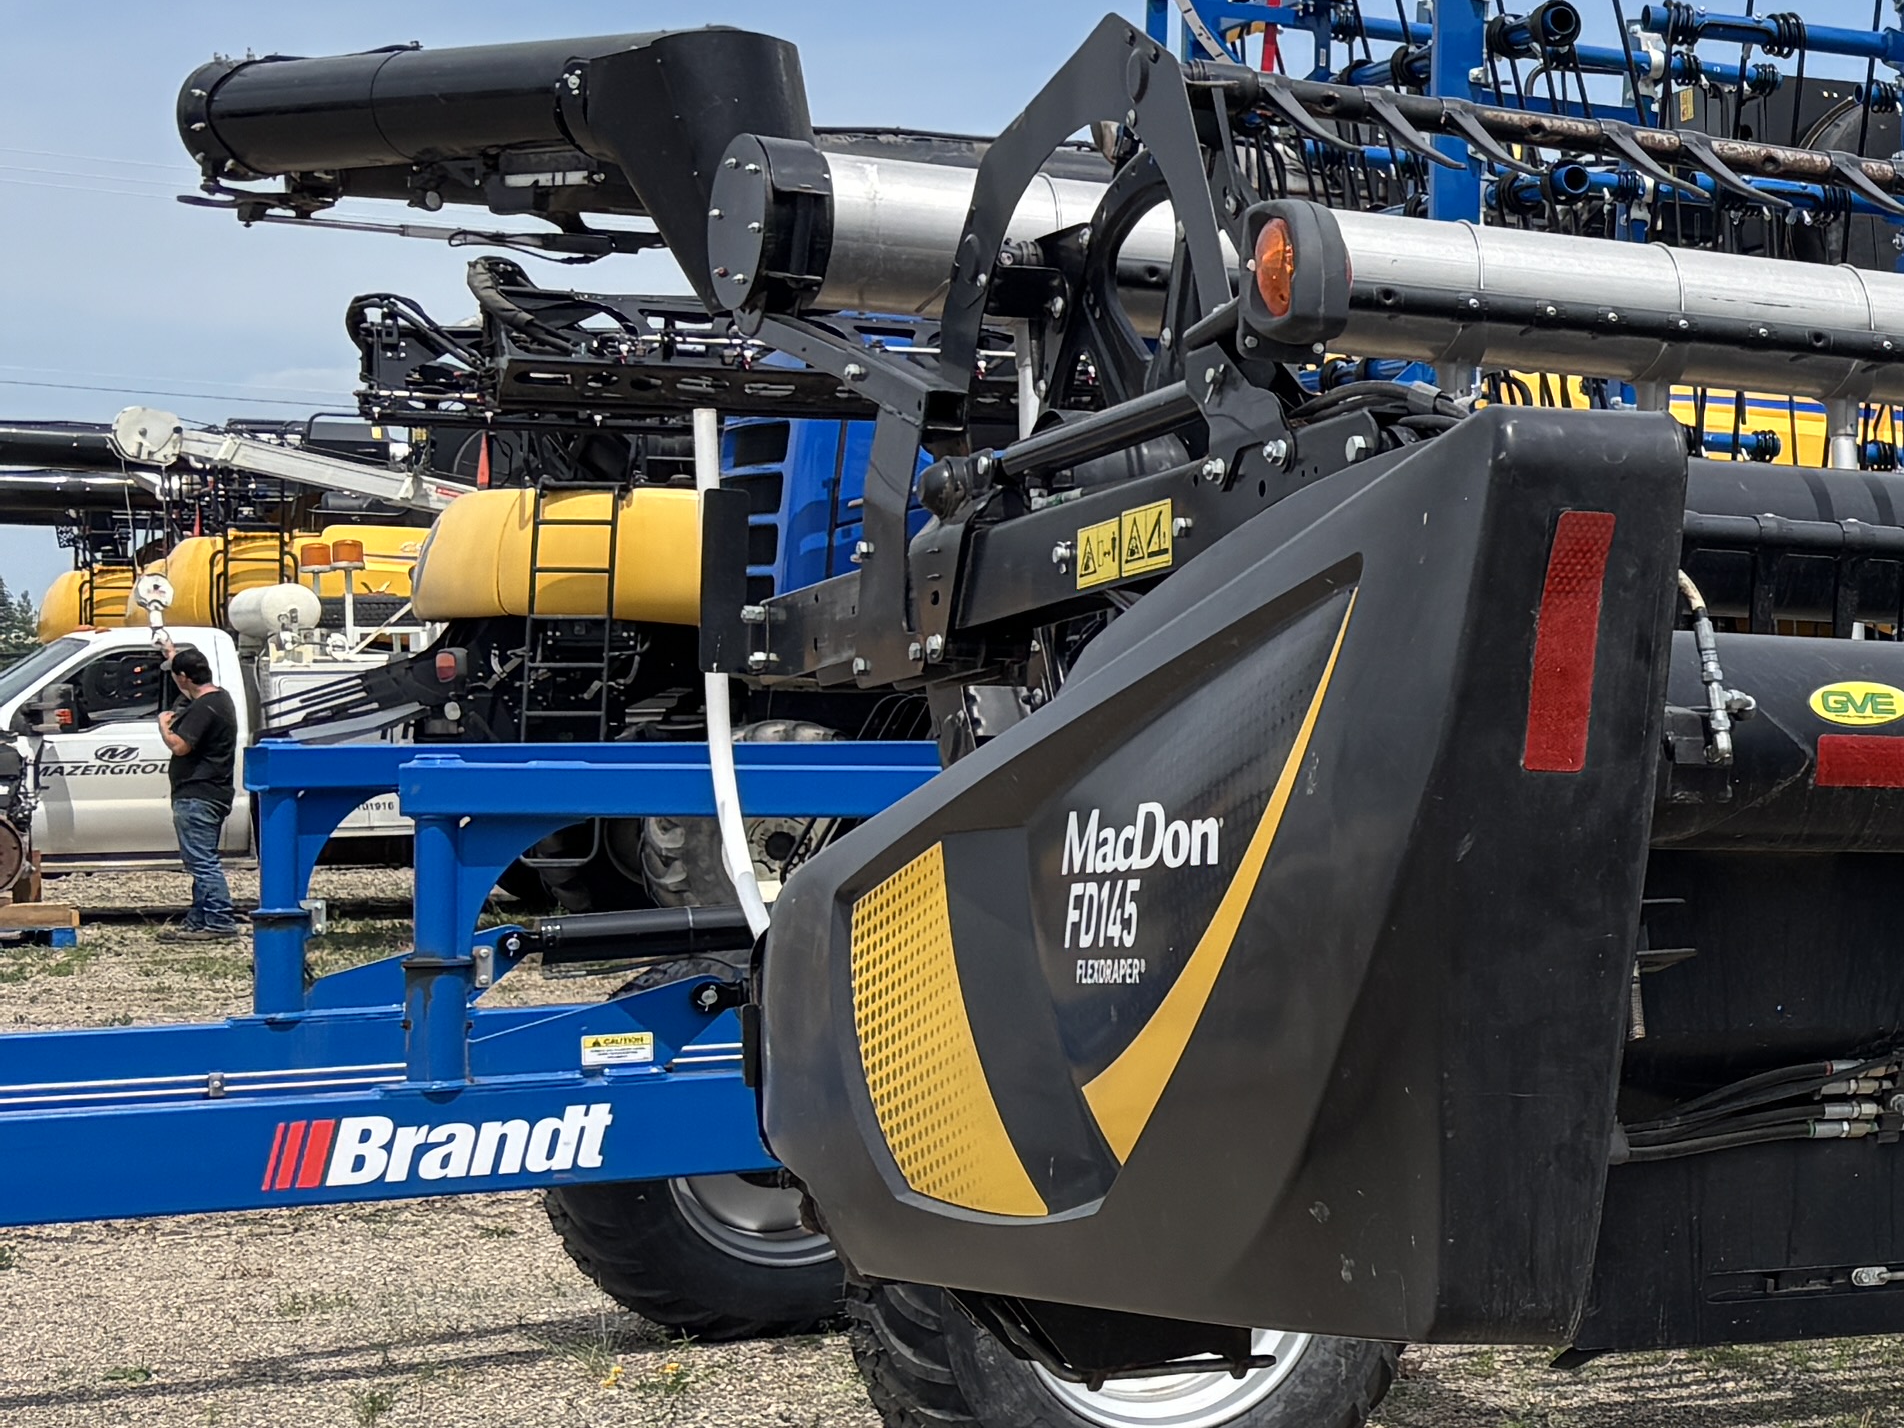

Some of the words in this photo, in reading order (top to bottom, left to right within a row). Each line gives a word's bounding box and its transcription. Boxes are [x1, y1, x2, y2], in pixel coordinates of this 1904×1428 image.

[1821, 690, 1897, 715] GVE
[1061, 801, 1220, 876] MacDon
[1064, 878, 1141, 949] FD145
[603, 1036, 644, 1045] CAUTION
[325, 1102, 614, 1187] Brandt
